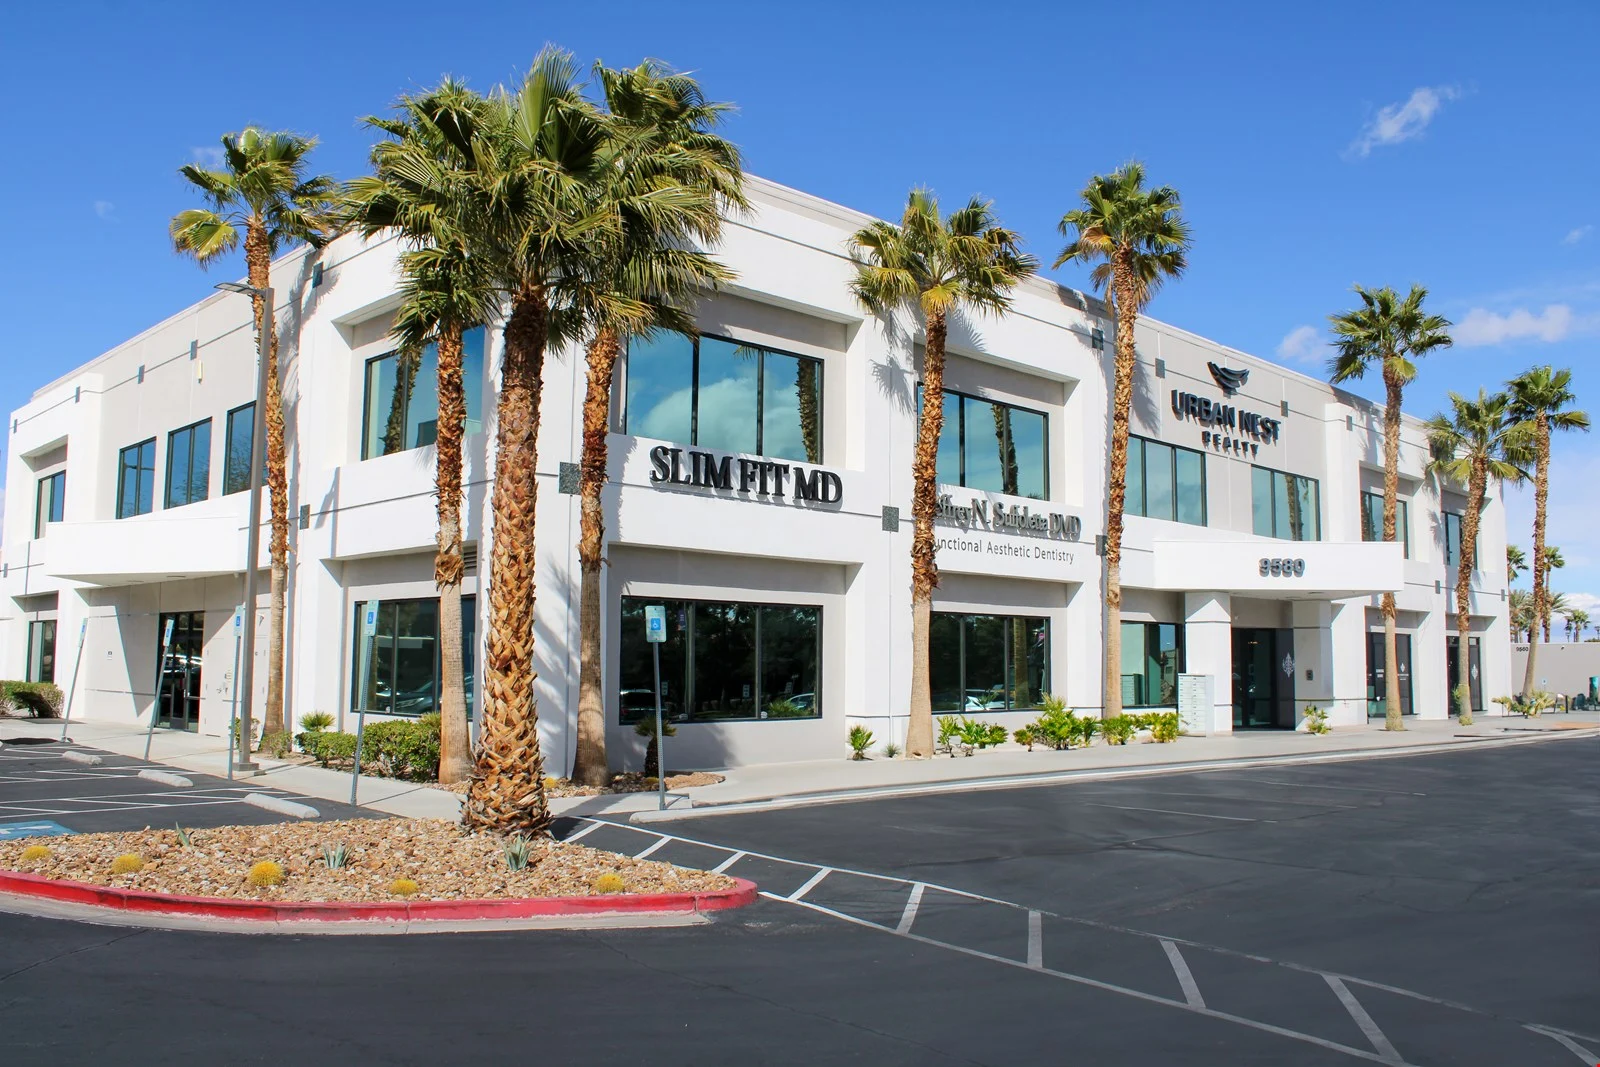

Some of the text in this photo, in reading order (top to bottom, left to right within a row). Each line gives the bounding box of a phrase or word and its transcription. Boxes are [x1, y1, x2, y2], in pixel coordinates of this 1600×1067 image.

[1170, 389, 1281, 442] URBAN NEST
[1201, 430, 1259, 457] REALTY
[649, 445, 843, 504] SLIM FIT MD
[934, 494, 971, 527] effrey
[1049, 512, 1082, 535] DMD
[934, 538, 1075, 565] unctional Aesthetic Dentistry
